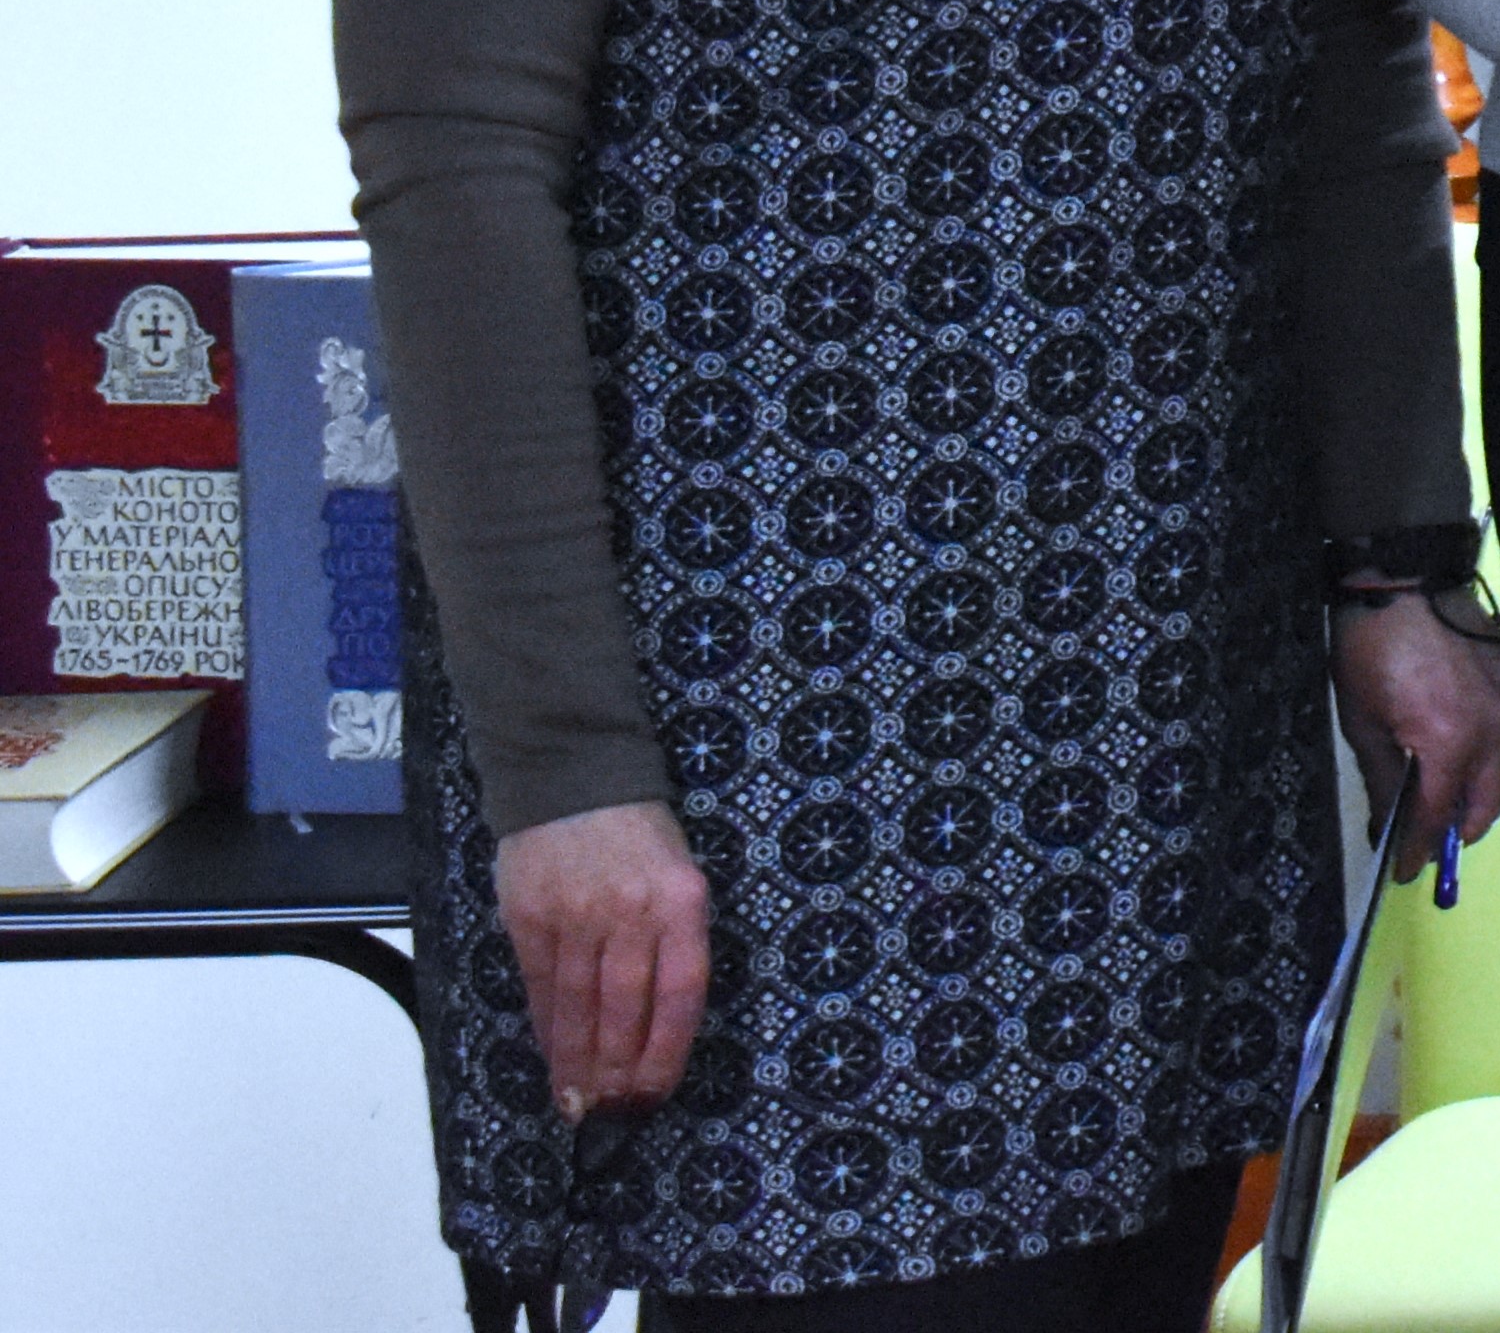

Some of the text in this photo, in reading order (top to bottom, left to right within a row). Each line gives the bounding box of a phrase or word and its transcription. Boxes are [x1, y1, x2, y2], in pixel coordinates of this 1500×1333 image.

[118, 476, 214, 498] МІСТО
[112, 500, 240, 524] КОНОТО
[54, 526, 240, 548] У МАТЕРІАЛ
[55, 550, 241, 573] ГЕНЕРАЛЬНО
[54, 599, 243, 622] ЛІВОБЕРЕЖН
[58, 647, 246, 673] 1765-1769 РОК
